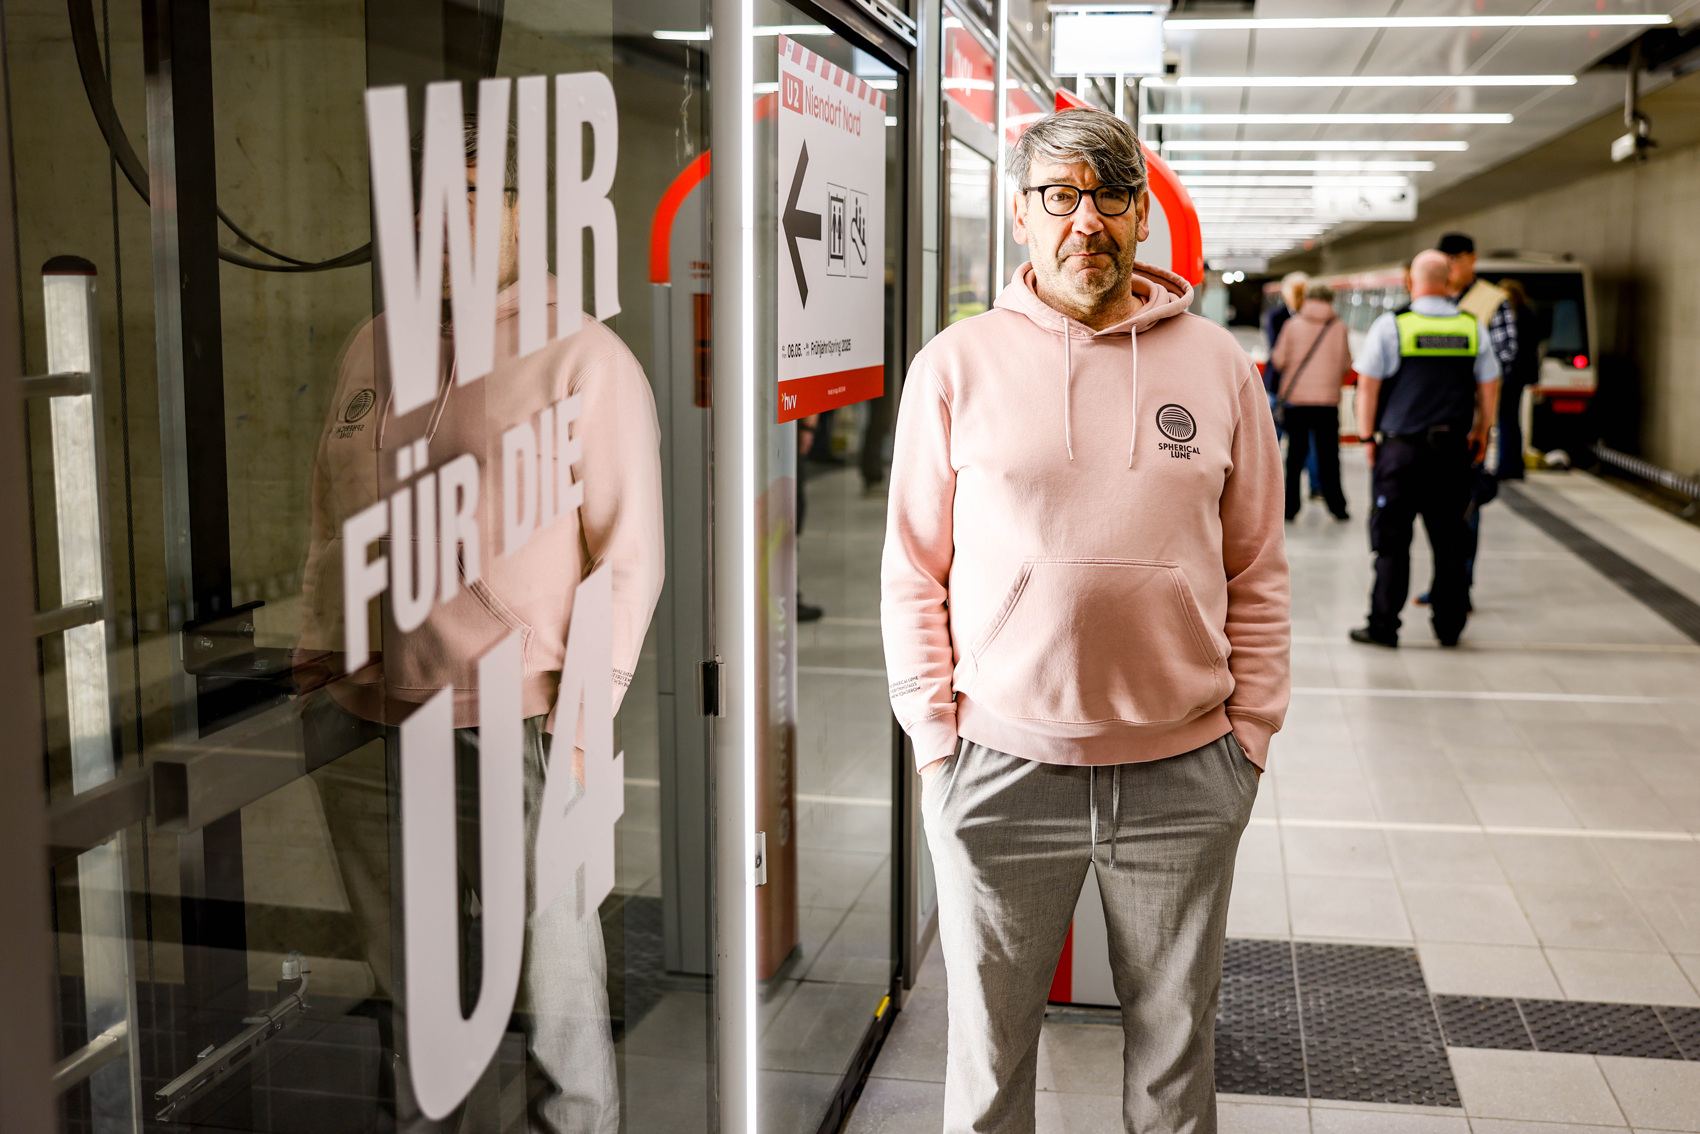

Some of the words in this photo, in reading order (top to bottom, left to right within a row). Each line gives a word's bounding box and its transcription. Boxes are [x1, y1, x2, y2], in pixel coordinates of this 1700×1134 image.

[786, 78, 799, 109] U2
[805, 85, 841, 128] Niendorf
[843, 105, 861, 137] Nord
[365, 71, 622, 417] WIR
[787, 343, 802, 358] 06.05.
[784, 392, 797, 411] hvv
[1158, 443, 1201, 455] SPHERICAL
[1170, 451, 1191, 460] LUNE
[343, 437, 482, 674] FÜR
[502, 392, 584, 560] DIE
[401, 558, 624, 1120] U4
